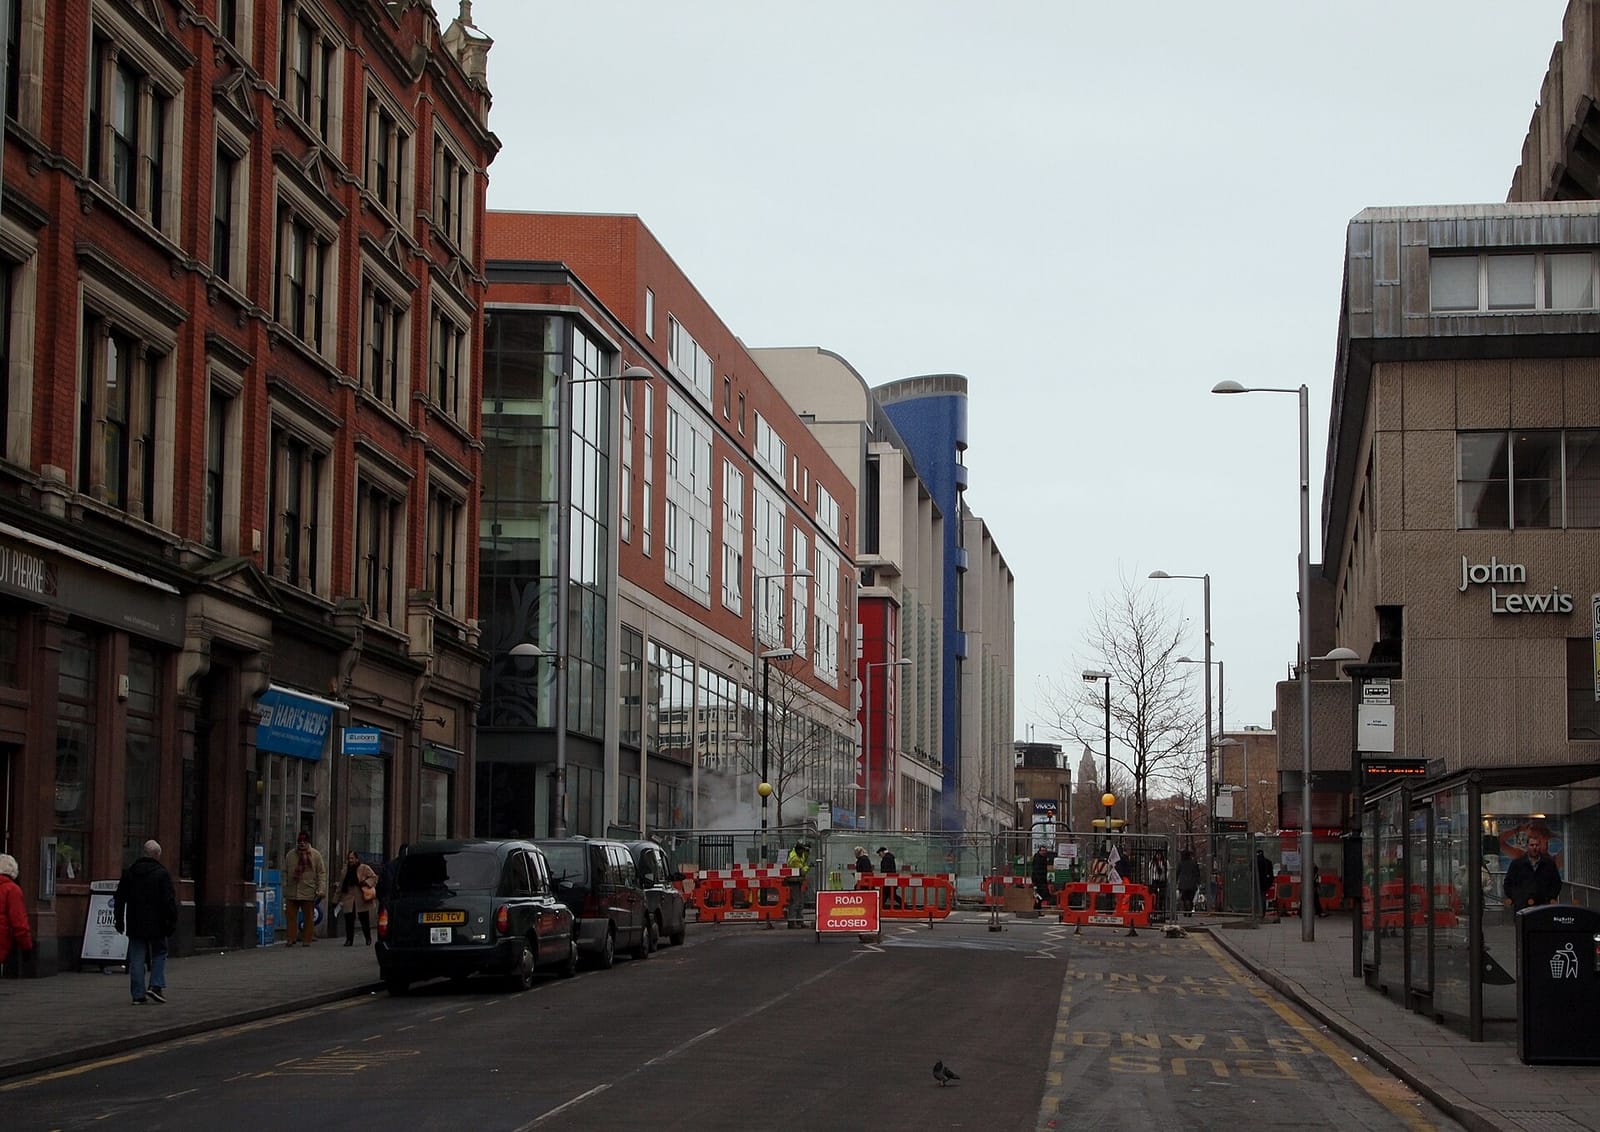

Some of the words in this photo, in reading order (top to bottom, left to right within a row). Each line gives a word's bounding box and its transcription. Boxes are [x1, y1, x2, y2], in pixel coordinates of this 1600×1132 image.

[12, 550, 44, 593] PIERRE
[1458, 555, 1526, 592] John
[1491, 586, 1574, 614] Lewis
[274, 704, 305, 731] HARI'S
[303, 711, 328, 736] NEWS
[835, 896, 863, 905] ROAD
[827, 919, 868, 928] CLOSED
[1072, 1032, 1315, 1054] STAND
[1108, 1055, 1300, 1080] BUS
